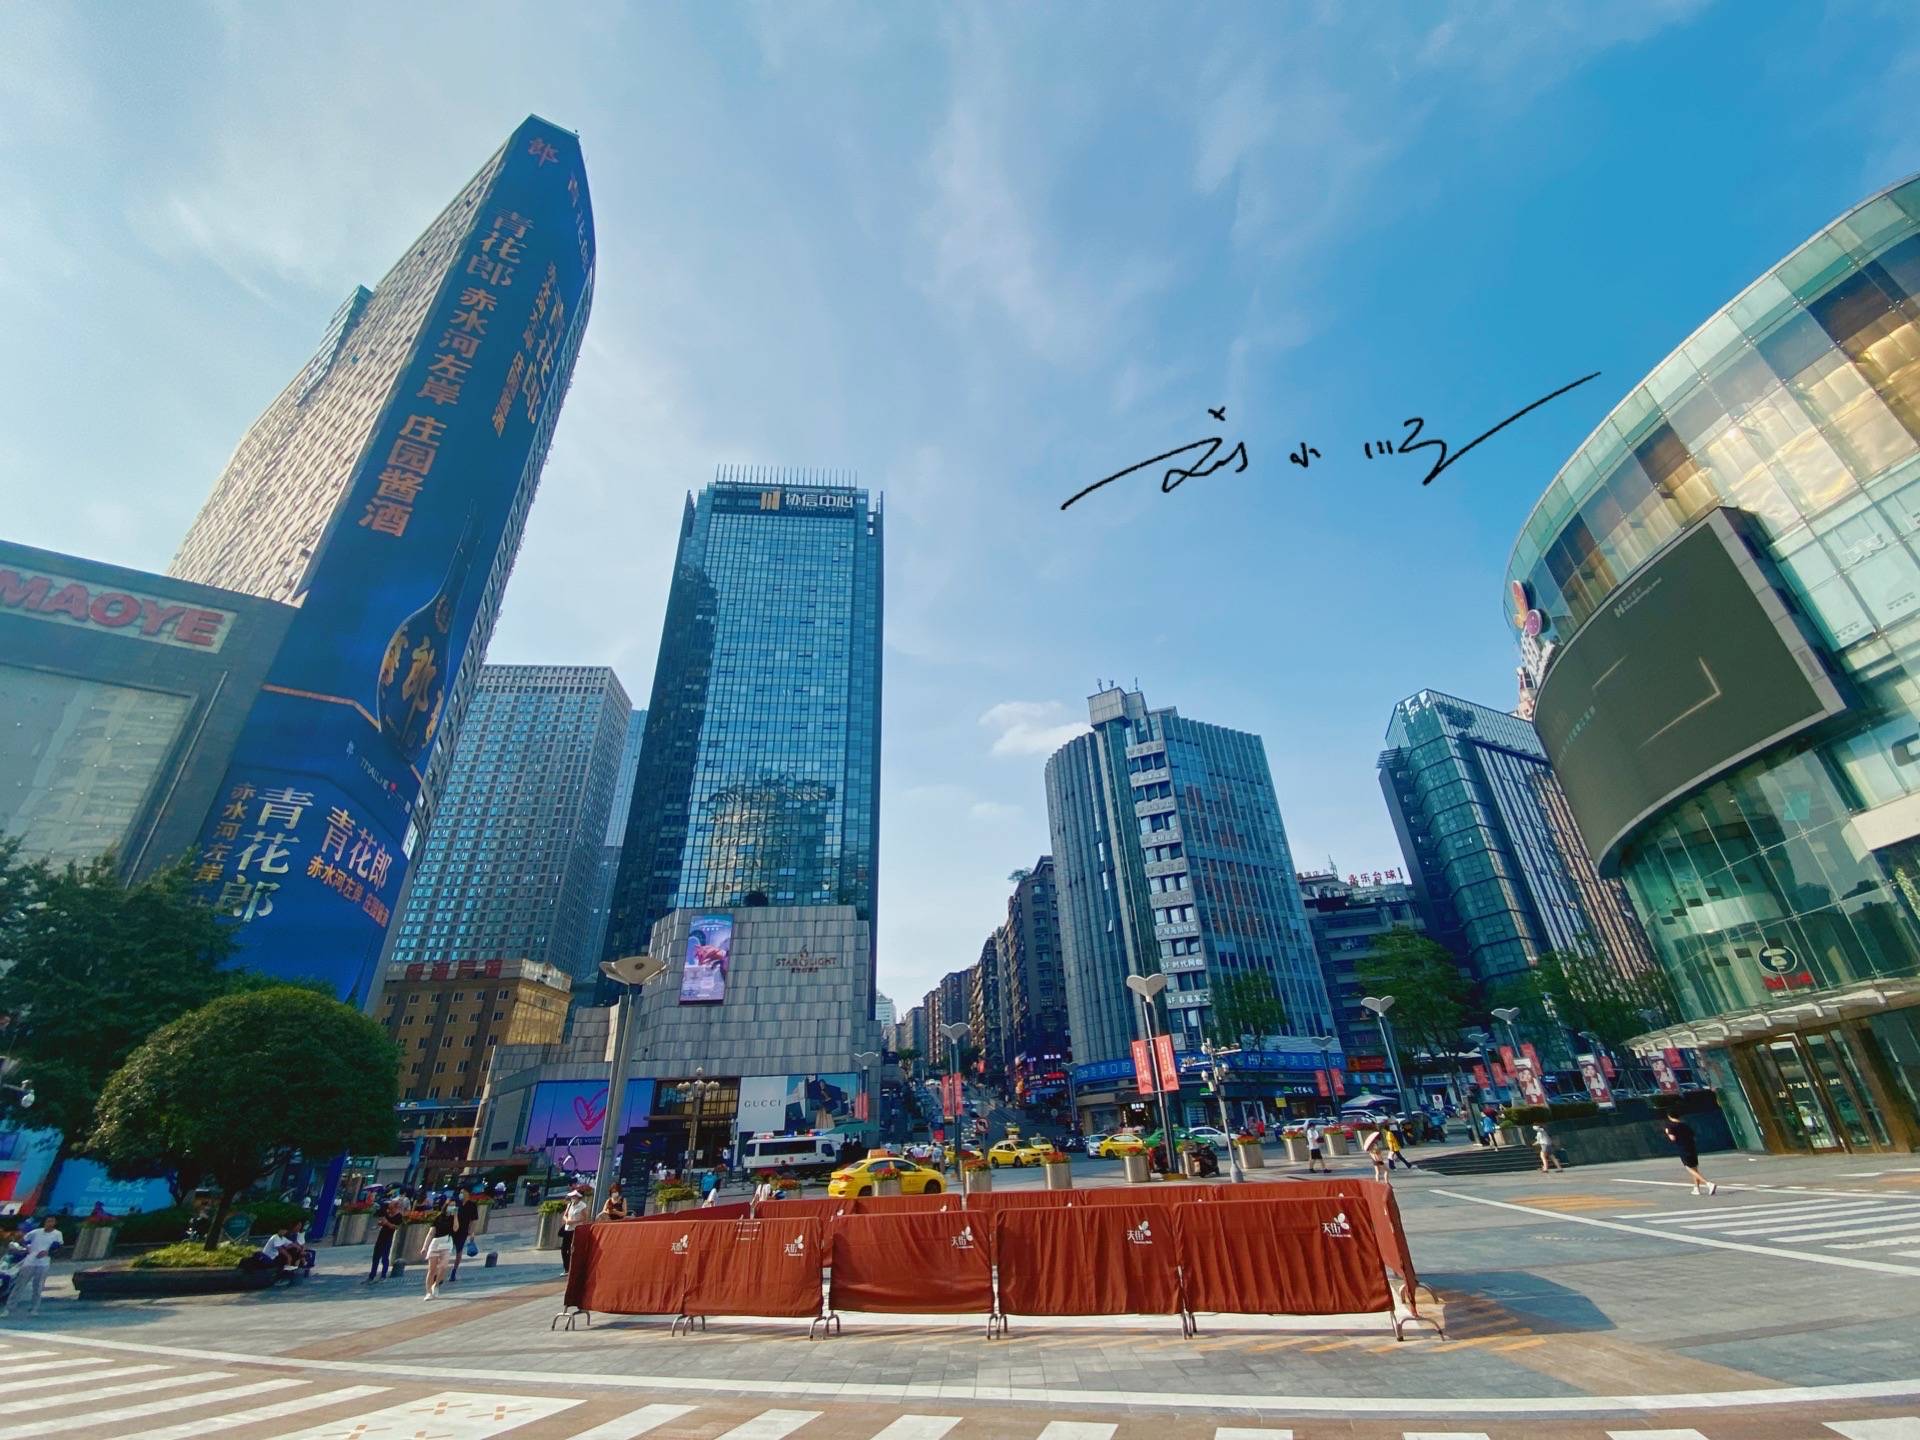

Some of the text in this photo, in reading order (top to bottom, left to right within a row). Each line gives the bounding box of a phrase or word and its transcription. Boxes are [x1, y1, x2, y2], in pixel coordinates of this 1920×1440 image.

[528, 138, 559, 168] 郎
[358, 207, 535, 538] 青花郎 赤水河左岸 庄园酱酒
[785, 492, 853, 508] 协信中心
[0, 568, 224, 647] MAOYE
[193, 783, 256, 882] 赤水河左岸
[217, 786, 314, 922] 青花郎
[321, 806, 393, 891] 青花郎
[307, 855, 365, 902] 赤水河左岸
[744, 1098, 781, 1108] GUCCI
